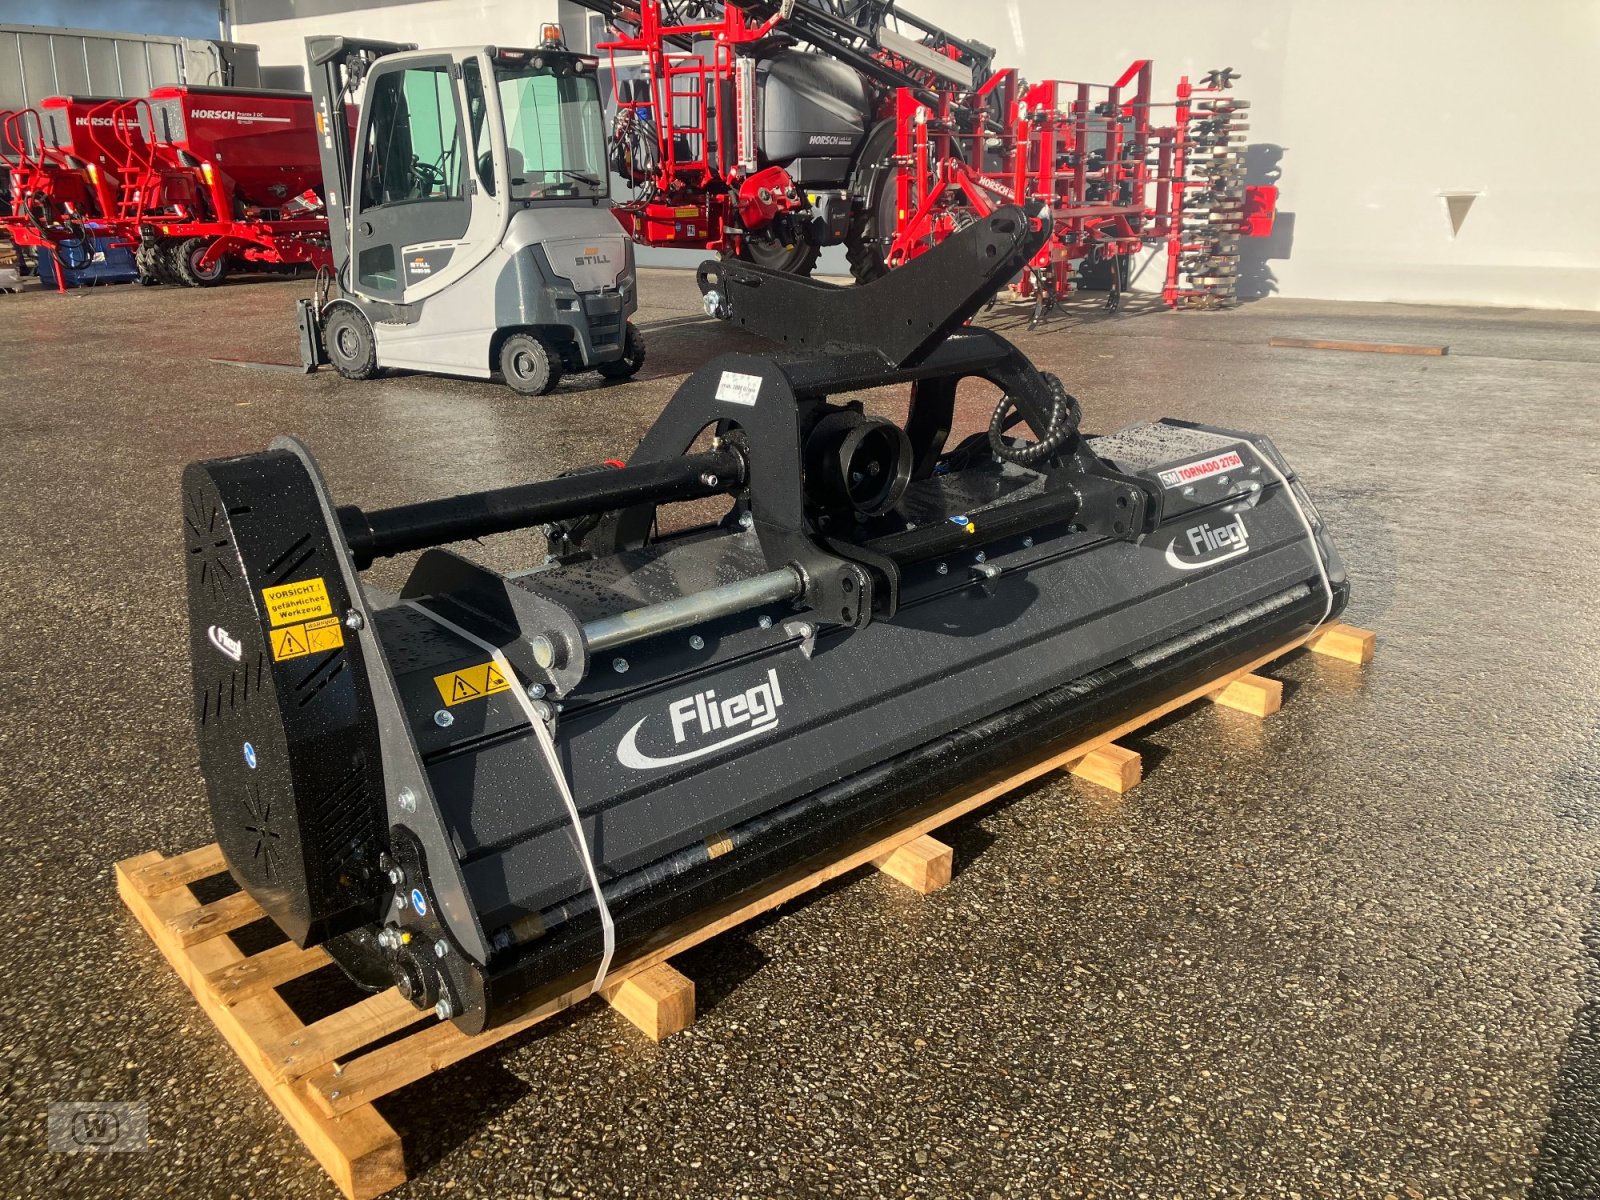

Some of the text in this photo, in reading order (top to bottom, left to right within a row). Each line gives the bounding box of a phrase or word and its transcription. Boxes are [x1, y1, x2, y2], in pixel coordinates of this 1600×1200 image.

[191, 109, 236, 120] HORSCH
[809, 135, 839, 145] HORSCH
[978, 175, 1010, 196] HORSCH
[574, 254, 611, 266] STILL
[1162, 454, 1241, 486] SM TORNADO 2750
[1185, 513, 1249, 556] Fliegl
[269, 585, 315, 600] VORSICHT
[272, 595, 325, 612] gefährliches
[279, 605, 322, 618] Werkzeug
[217, 627, 242, 658] Fliegl
[669, 668, 783, 744] Fliegl
